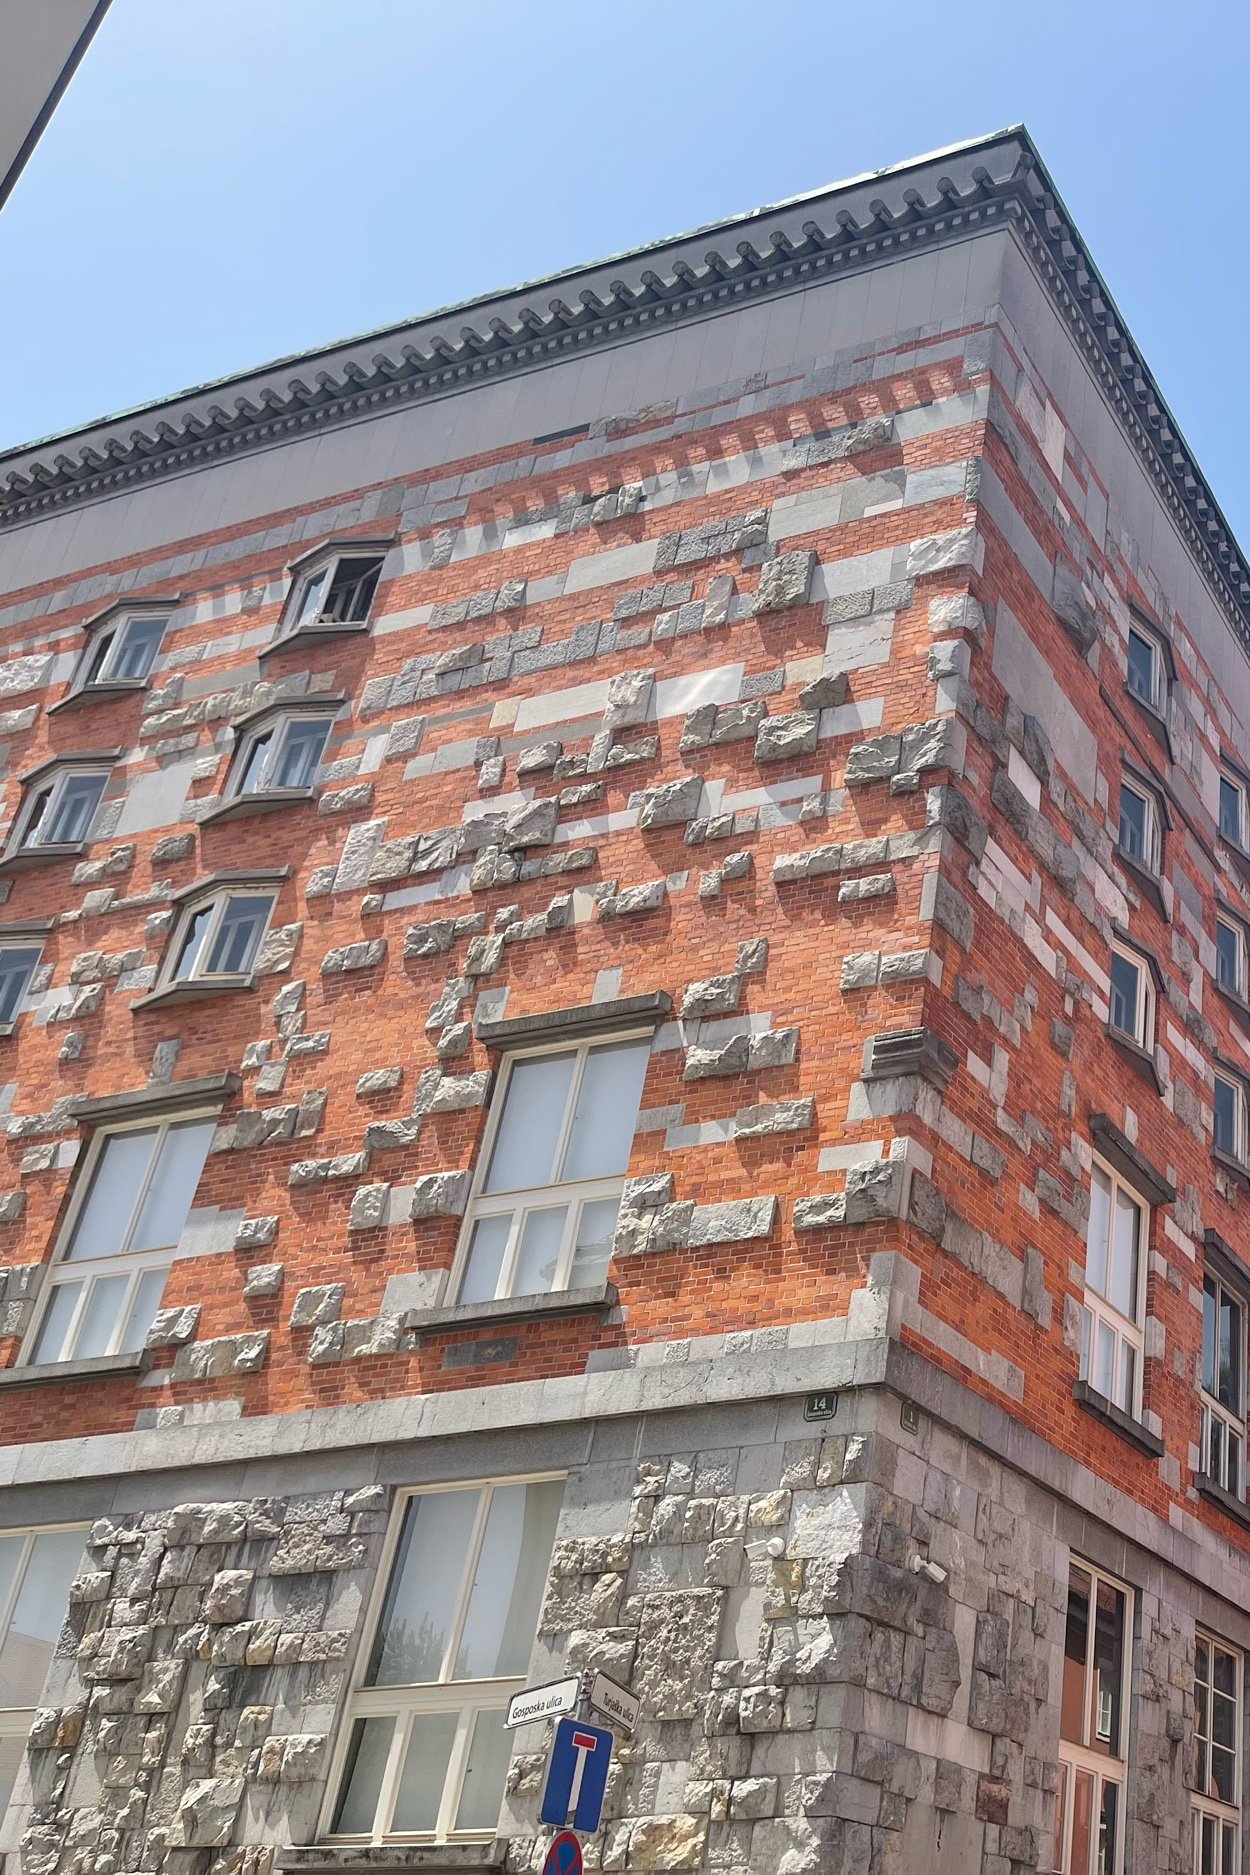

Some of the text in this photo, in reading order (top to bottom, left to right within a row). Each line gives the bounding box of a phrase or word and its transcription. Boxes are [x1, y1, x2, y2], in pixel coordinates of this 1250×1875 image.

[812, 1397, 827, 1410] 14
[909, 1411, 914, 1422] 1
[512, 1696, 563, 1719] Gosposka ulica
[622, 1707, 634, 1723] ulica
